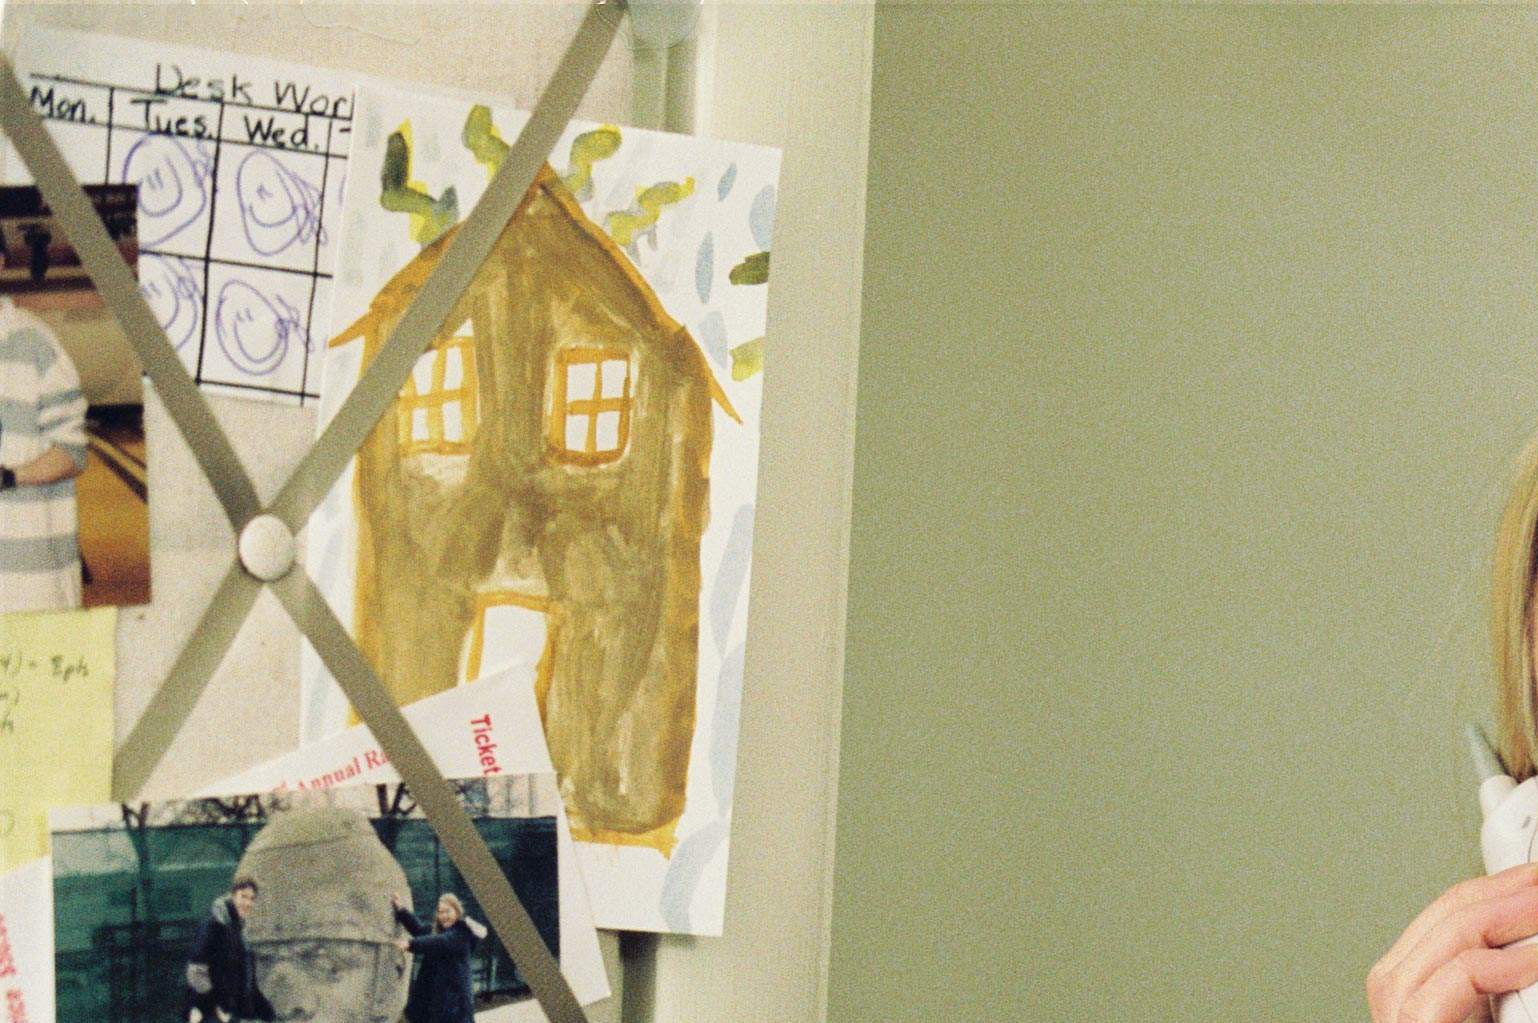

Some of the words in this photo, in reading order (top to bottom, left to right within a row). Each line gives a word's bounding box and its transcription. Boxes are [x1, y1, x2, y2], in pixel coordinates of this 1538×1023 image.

[155, 62, 252, 100] Desk
[30, 85, 97, 124] Mon.
[131, 98, 216, 140] Tues.
[243, 112, 320, 150] Wed.
[469, 713, 502, 776] Ticket
